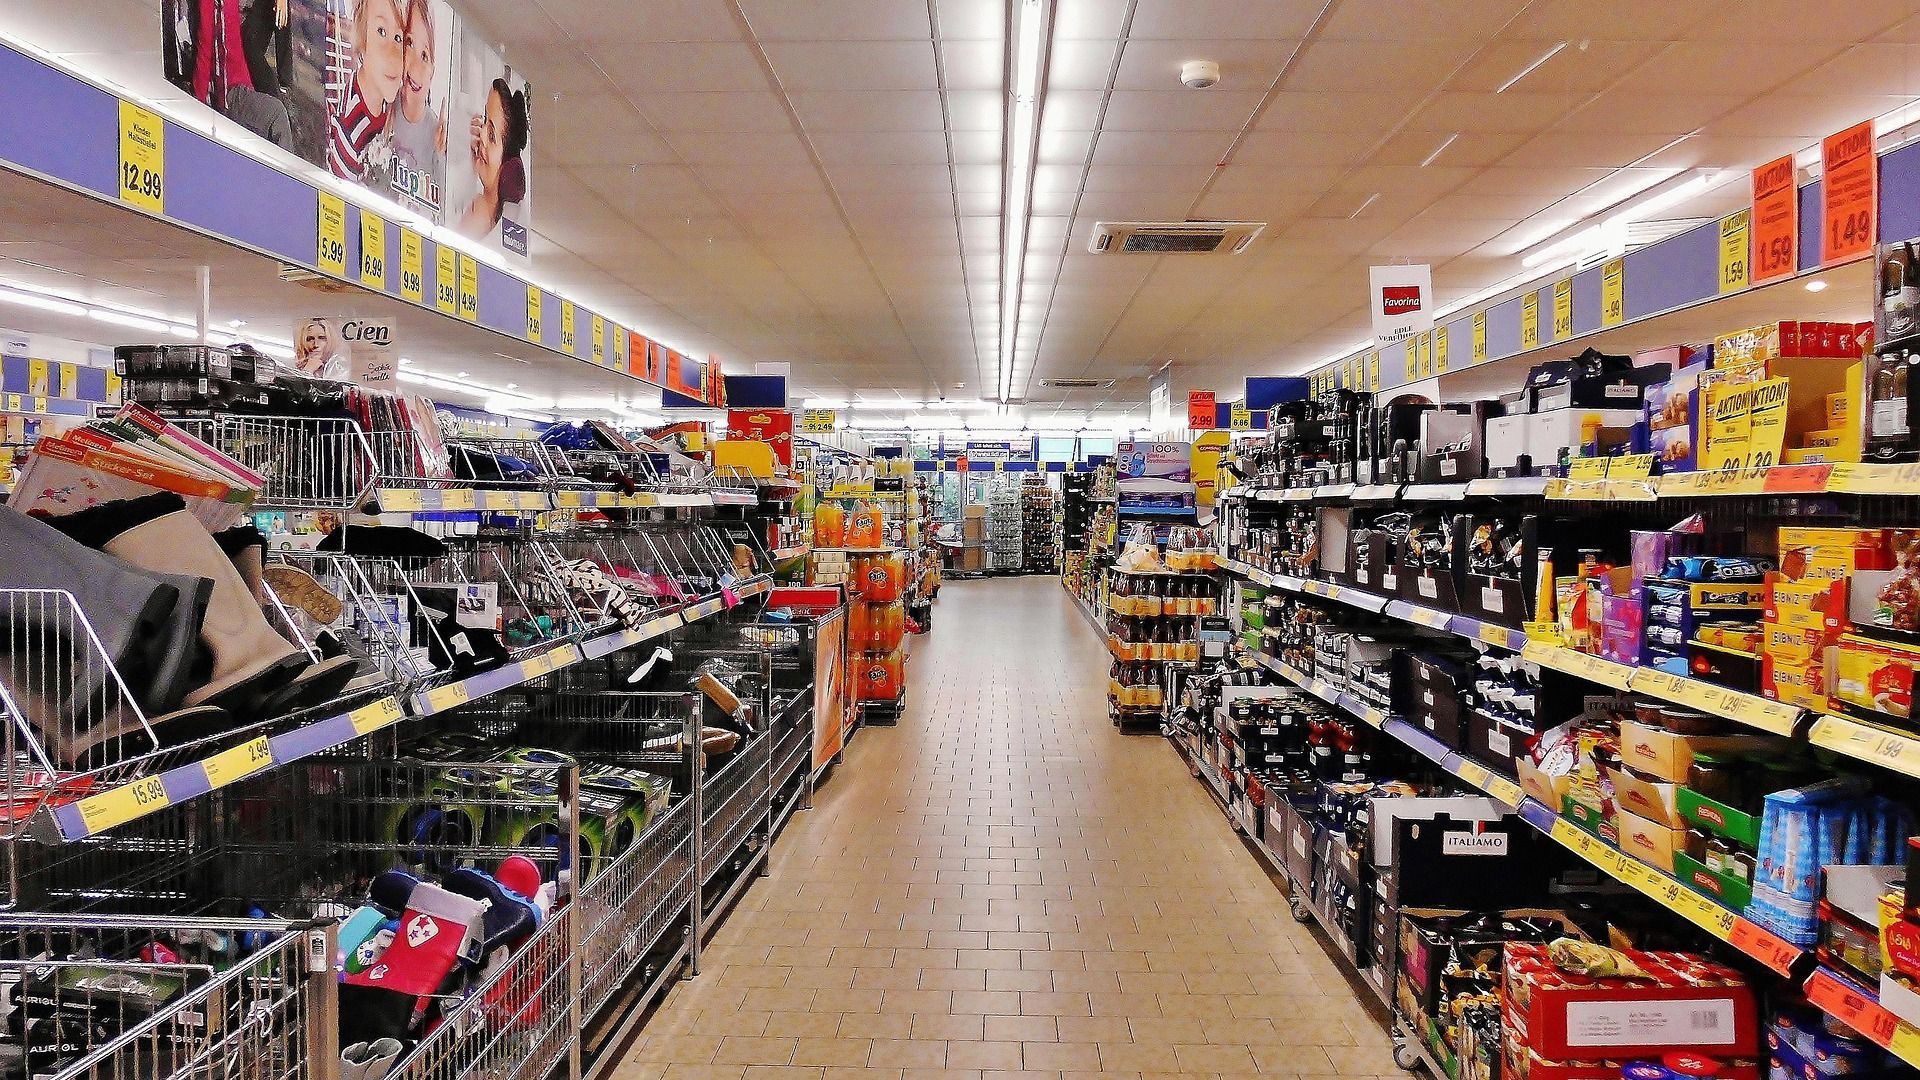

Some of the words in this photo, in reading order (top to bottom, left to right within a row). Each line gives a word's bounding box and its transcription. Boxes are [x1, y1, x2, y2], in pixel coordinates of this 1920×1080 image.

[123, 161, 161, 199] 12.99
[393, 158, 439, 204] lupilu
[1832, 210, 1870, 250] 1.49
[321, 237, 343, 263] 5.99
[364, 254, 382, 278] 6.99
[403, 270, 420, 293] 9.99
[439, 283, 454, 304] 3.99
[461, 292, 476, 312] 4.99
[1384, 297, 1420, 307] Favorina
[341, 321, 389, 341] Cien
[817, 423, 833, 431] 2.49
[1191, 415, 1213, 426] 2.99
[1151, 444, 1179, 453] 100%
[856, 518, 873, 528] Fanta
[868, 571, 887, 581] Fanta
[1773, 592, 1800, 605] EIBNIZ
[1773, 670, 1801, 686] EIBNIZ
[381, 696, 397, 715] 9.99
[248, 739, 270, 762] 2.99
[132, 779, 164, 805] 15.99
[1449, 837, 1502, 847] ITALIAMO
[1715, 912, 1734, 931] -.99
[30, 1043, 79, 1053] AUROL
